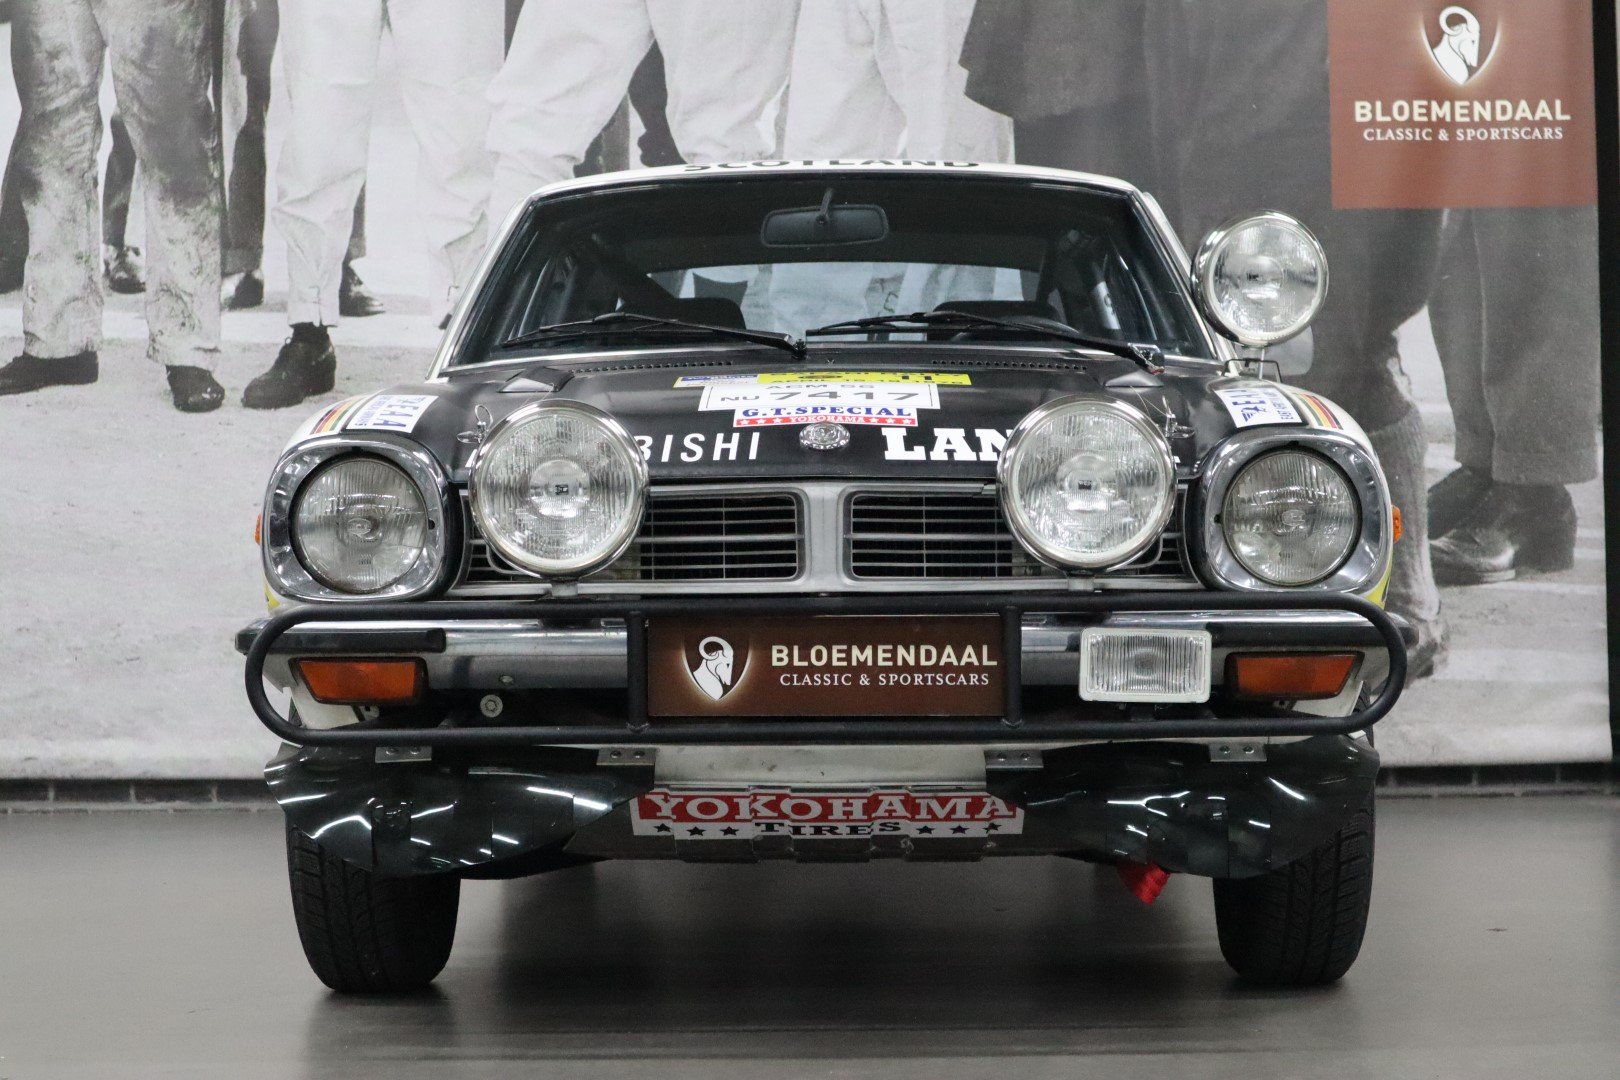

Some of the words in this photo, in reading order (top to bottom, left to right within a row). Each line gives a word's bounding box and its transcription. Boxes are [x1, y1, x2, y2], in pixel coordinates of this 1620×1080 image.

[1354, 99, 1572, 122] BLOEMENDAAL
[1363, 128, 1432, 141] CLASSIC
[1438, 129, 1449, 141] &
[1456, 127, 1564, 141] SPORTSCARS
[770, 391, 920, 401] 7417
[771, 644, 998, 667] BLOEMENDAAL
[780, 673, 852, 686] CLASSIC
[859, 673, 870, 686] &
[878, 673, 990, 686] SPORTSCARS
[645, 794, 1013, 820] YOKOHAMA
[755, 821, 902, 836] TIRES
